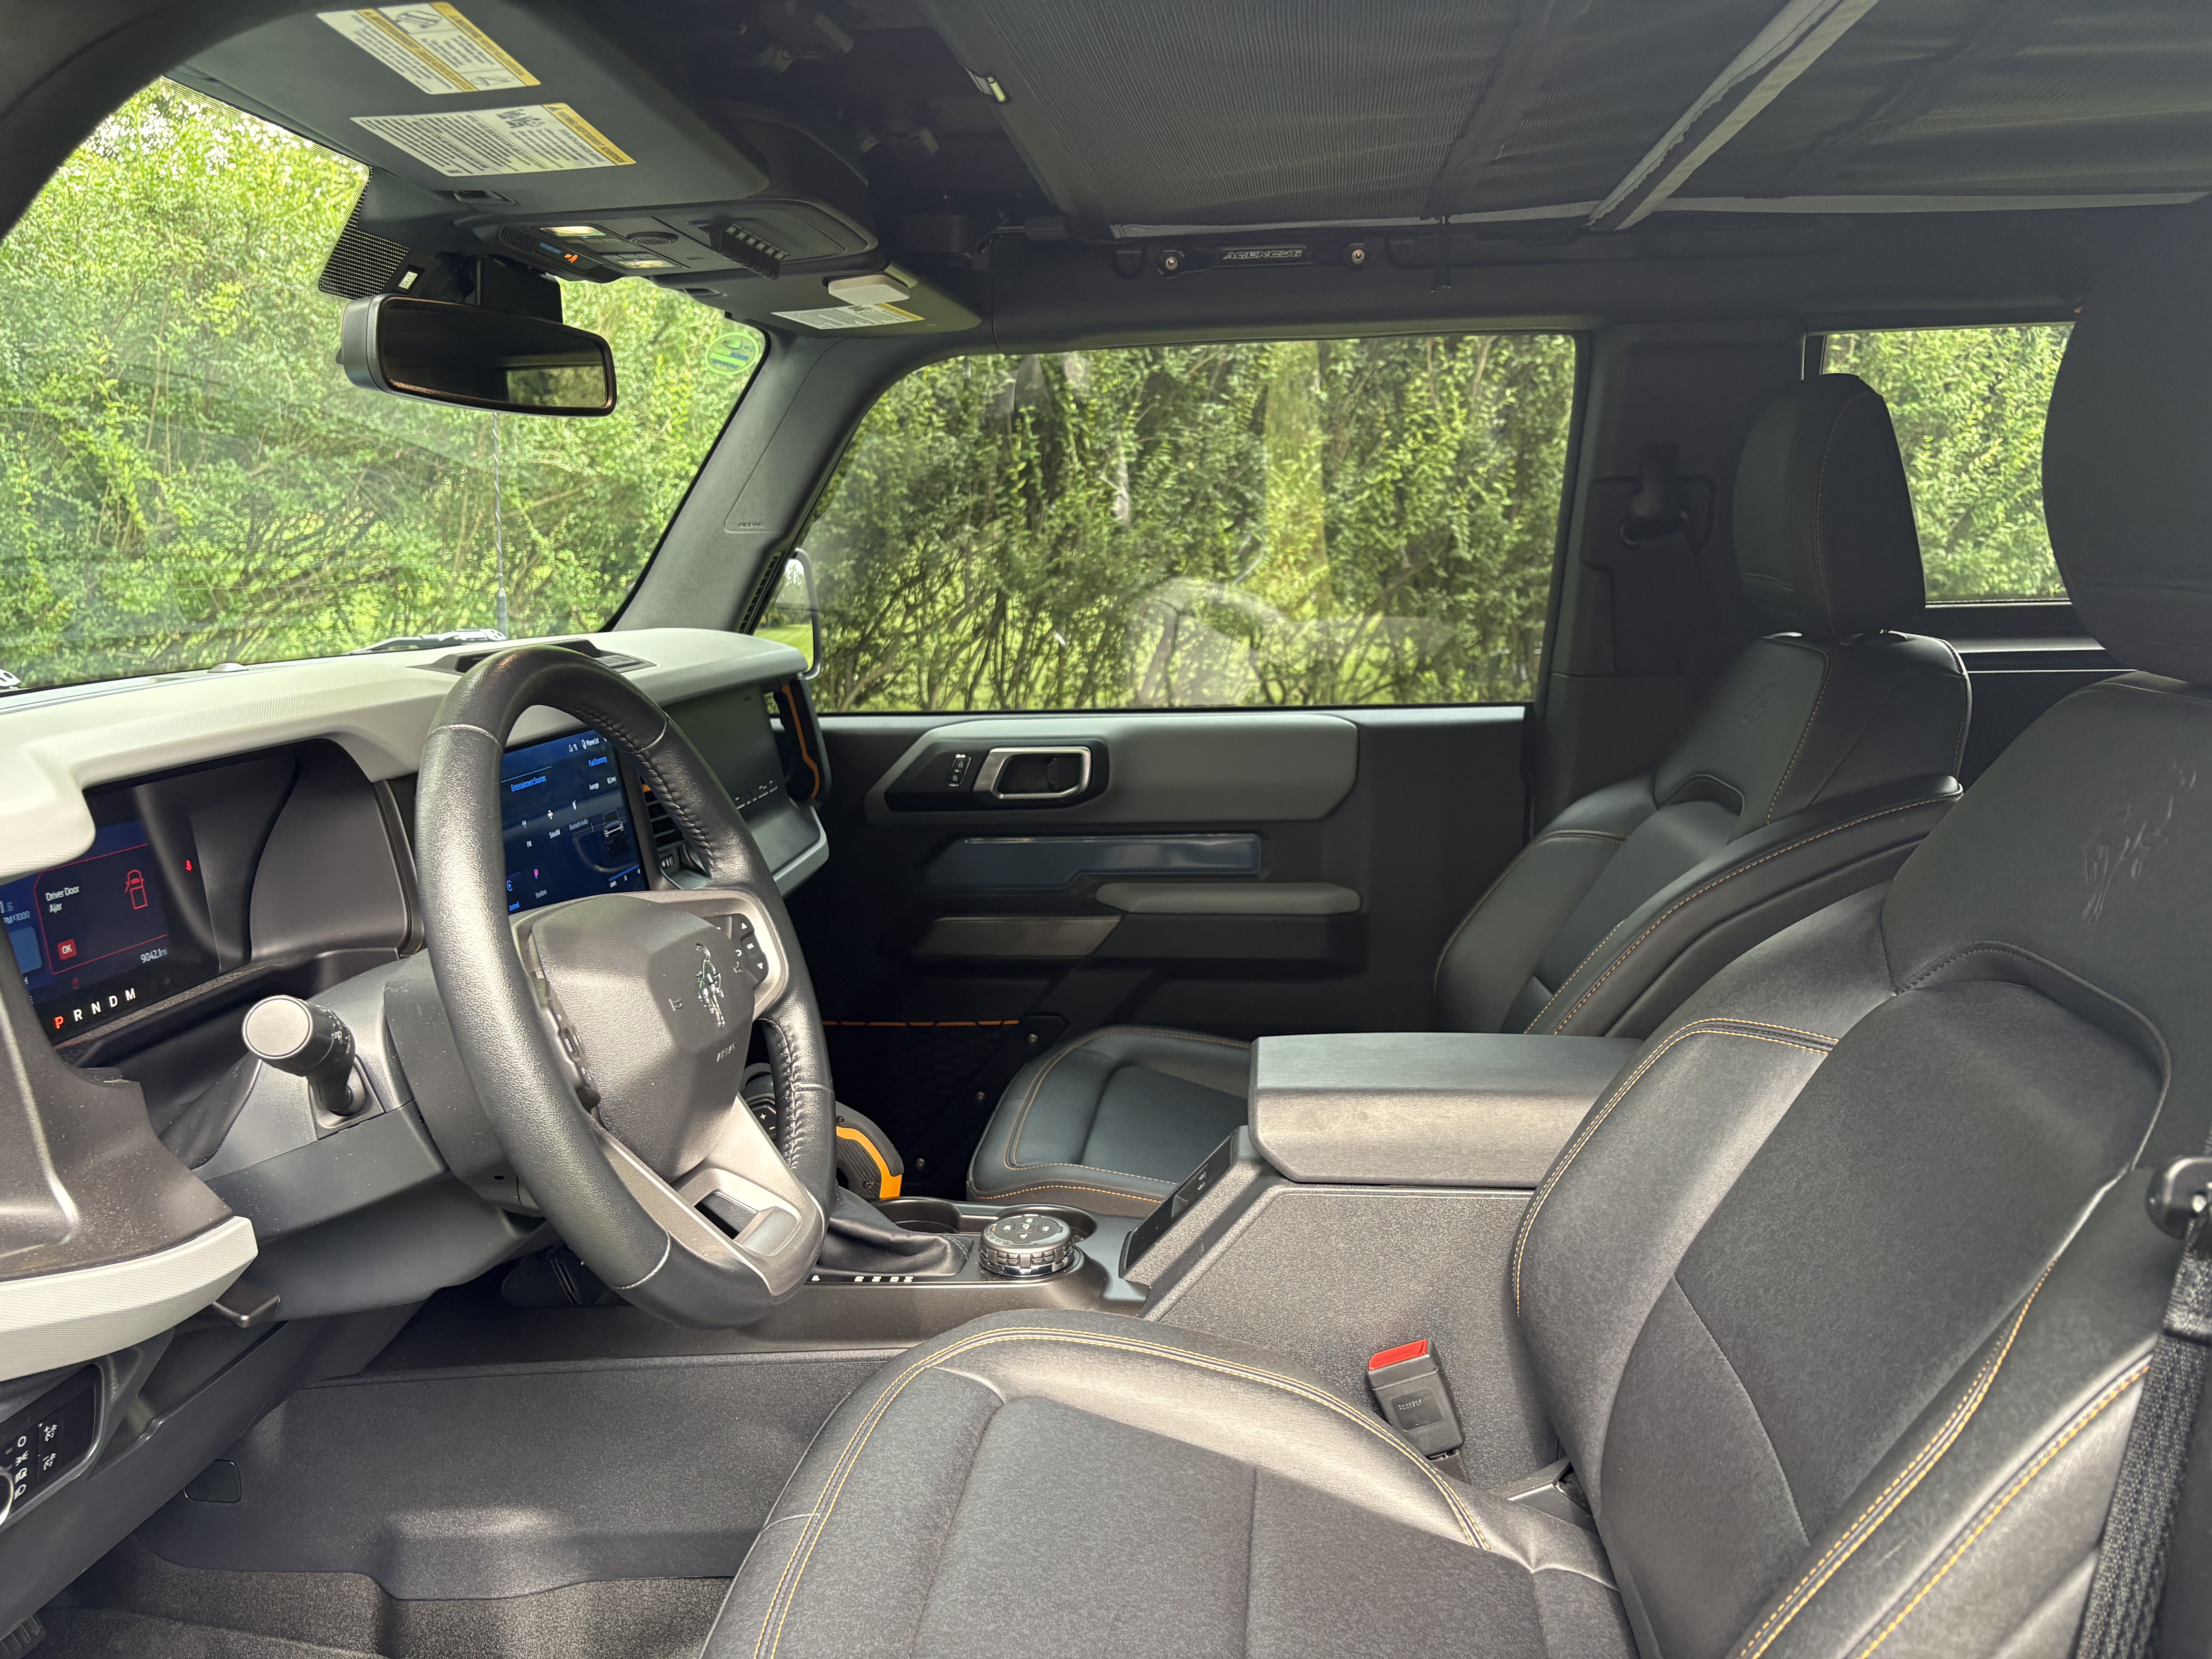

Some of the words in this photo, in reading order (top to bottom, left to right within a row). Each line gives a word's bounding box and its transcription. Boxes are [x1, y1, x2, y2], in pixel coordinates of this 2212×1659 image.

[511, 778, 534, 792] Entertainment
[534, 776, 546, 785] Sources
[46, 890, 64, 901] Driver
[64, 886, 80, 896] Door
[50, 903, 62, 913] Ajar
[62, 945, 72, 954] OK
[55, 1016, 65, 1029] P
[74, 1009, 83, 1022] R
[91, 1001, 101, 1015] N
[109, 995, 118, 1008] D
[125, 988, 136, 1001] M
